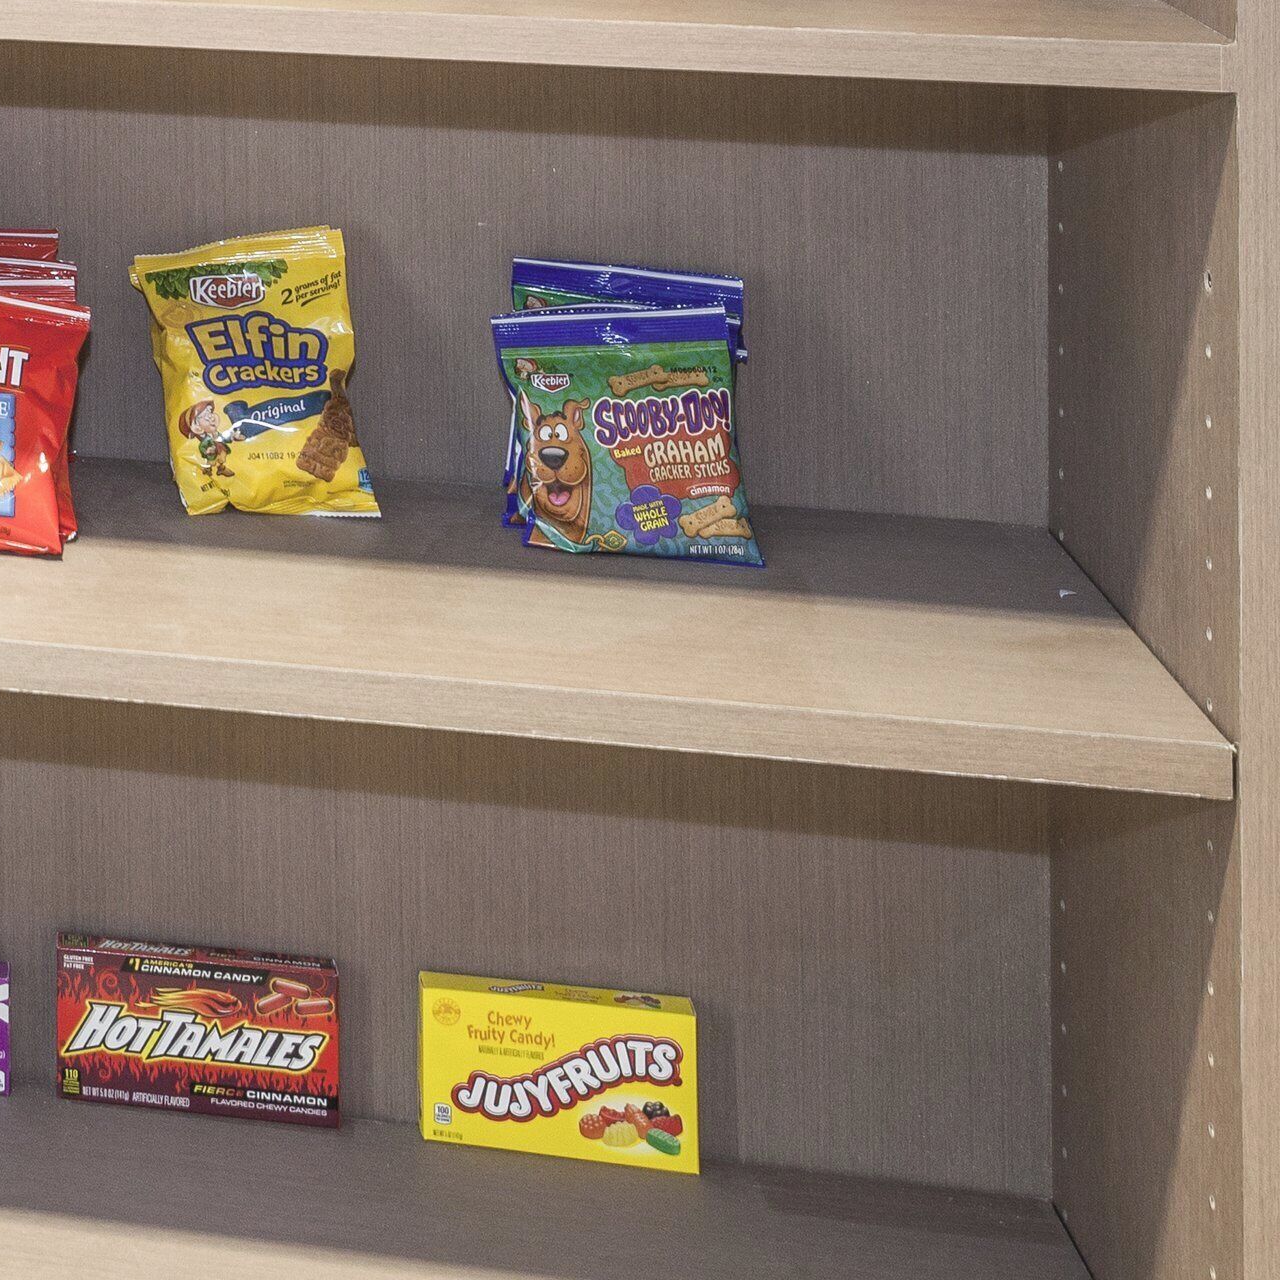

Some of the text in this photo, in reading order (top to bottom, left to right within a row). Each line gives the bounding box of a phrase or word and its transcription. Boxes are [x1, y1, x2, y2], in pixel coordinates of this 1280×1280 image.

[192, 277, 264, 301] Keebler
[191, 315, 321, 361] Elfin
[208, 363, 319, 387] Crackers
[533, 374, 569, 387] Keebler
[251, 400, 306, 422] Original
[595, 390, 730, 446] SCOOBY-DOO!
[613, 447, 641, 459] Baked
[644, 434, 725, 467] GRAHAM
[649, 460, 730, 483] CRACKER STICKS
[690, 485, 730, 496] cinnamon
[633, 507, 667, 523] WHOLE
[640, 518, 669, 531] GRAIN
[129, 958, 141, 971] #1
[140, 964, 211, 979] CINNAMON
[143, 959, 193, 969] AMERICA'S
[487, 1011, 532, 1028] Chewy
[68, 1003, 327, 1071] HOT TAMALES
[467, 1025, 556, 1048] Fruity Candy!
[458, 1040, 677, 1116] JUJYFRUITS
[193, 1085, 328, 1106] FIERCE CINNAMON
[210, 1097, 327, 1116] FLAVORED CHEWY CANDIES
